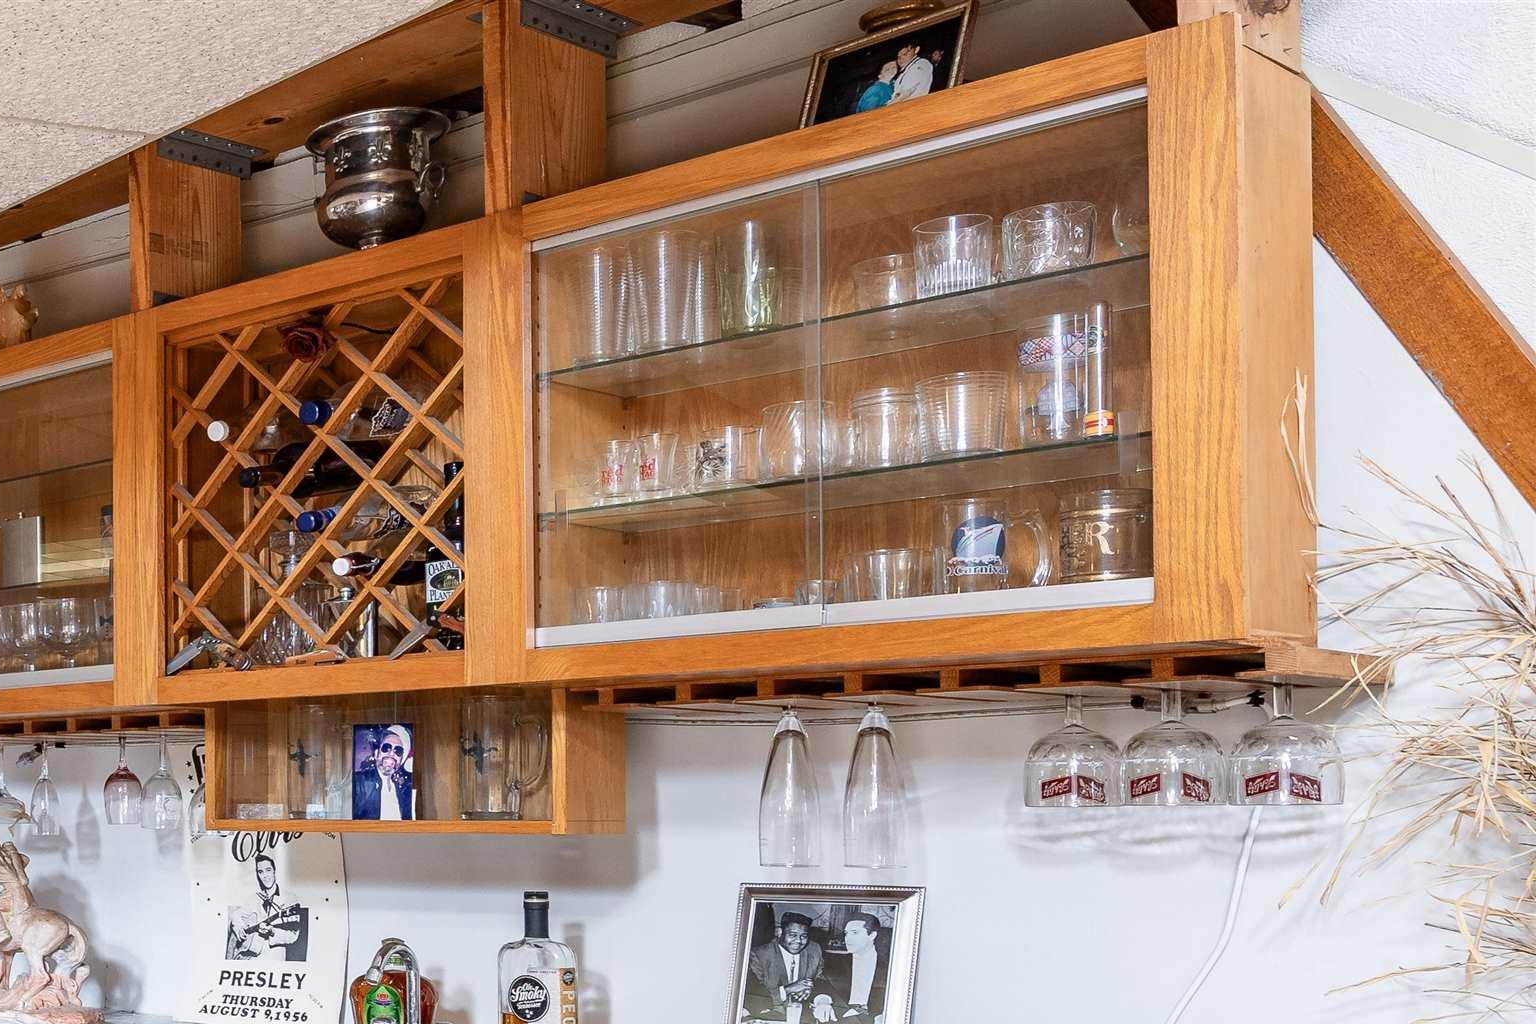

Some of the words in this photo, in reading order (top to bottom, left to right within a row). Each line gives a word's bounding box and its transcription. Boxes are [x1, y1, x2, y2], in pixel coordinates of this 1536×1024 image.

[218, 970, 306, 990] PRESLEY
[222, 994, 293, 1010] THURSDAY
[511, 985, 547, 1003] Smoky
[198, 1004, 260, 1019] AUGUST
[263, 1009, 309, 1023] 9,1956
